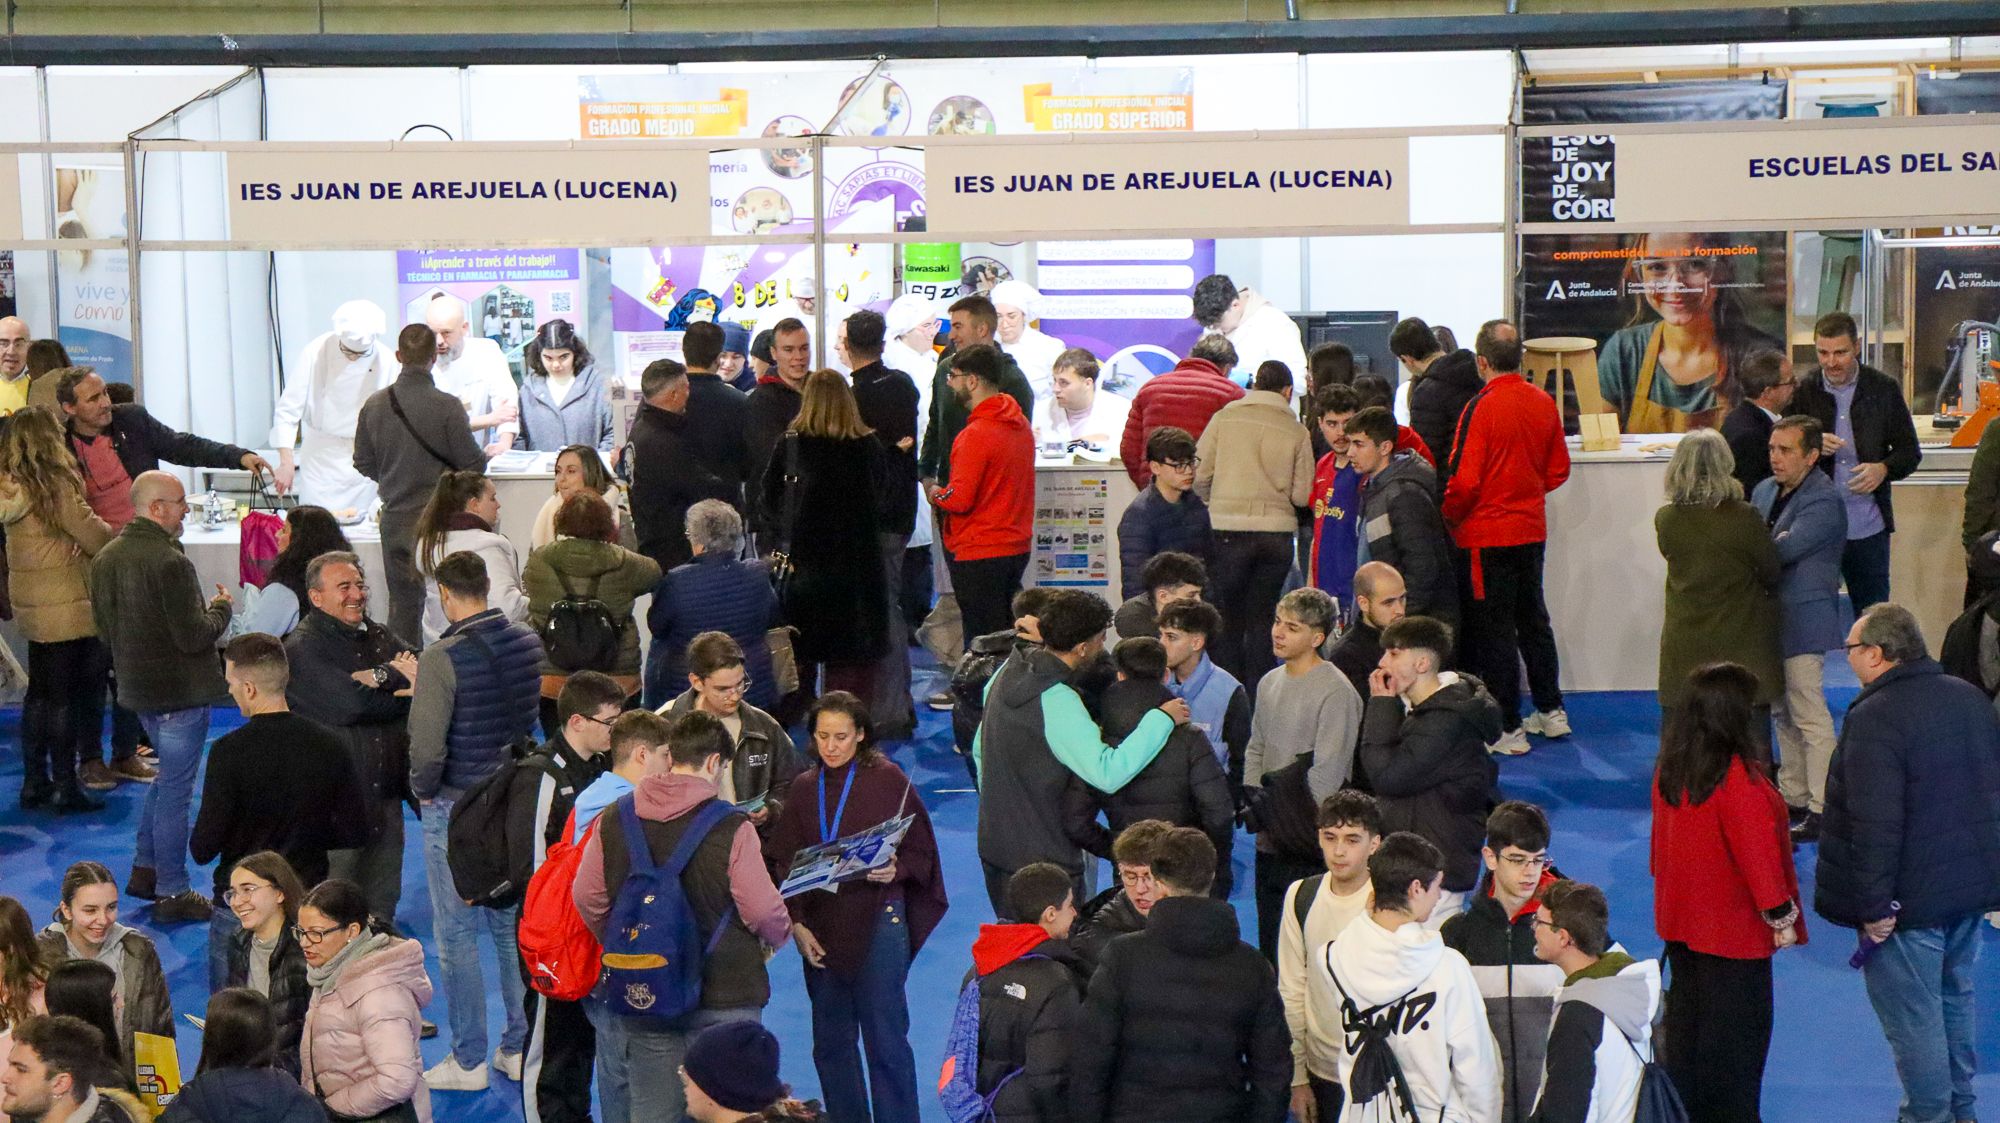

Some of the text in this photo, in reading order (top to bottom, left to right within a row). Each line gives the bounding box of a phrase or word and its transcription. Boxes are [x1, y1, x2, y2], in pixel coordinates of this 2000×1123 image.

[639, 103, 696, 114] PROFESIONAL
[699, 103, 730, 113] INICIAL
[1095, 97, 1153, 107] PROFESIONAL
[1155, 96, 1187, 106] INICIAL
[1052, 110, 1187, 129] GRADO SUPERIOR
[588, 118, 695, 136] GRADO MEDIO
[1552, 147, 1579, 161] DE
[1749, 151, 2000, 177] ESCUELAS DEL SA
[954, 169, 1393, 194] IES JUAN DE AREJUELA (LUCENA)
[241, 179, 678, 202] IES JUAN DE AREJUELA (LUCENA)
[1552, 184, 1579, 198] DE
[1552, 194, 1615, 220] CÓR
[1553, 248, 1650, 262] comprometidos
[1680, 247, 1691, 257] la
[1694, 244, 1758, 257] formación
[468, 258, 473, 267] a
[504, 255, 517, 267] del
[443, 271, 455, 281] EN
[456, 270, 498, 281] FARMACIA
[499, 270, 505, 279] Y
[507, 269, 570, 279] PARAFARMACIA
[905, 264, 950, 273] Kawasaki
[1090, 277, 1169, 286] ADMINISTRATIVA
[1568, 281, 1591, 290] Junta
[1958, 280, 1969, 288] de
[75, 282, 116, 300] vive
[733, 281, 746, 308] 8
[754, 280, 778, 308] DE
[1568, 287, 1618, 298] de Andalucía
